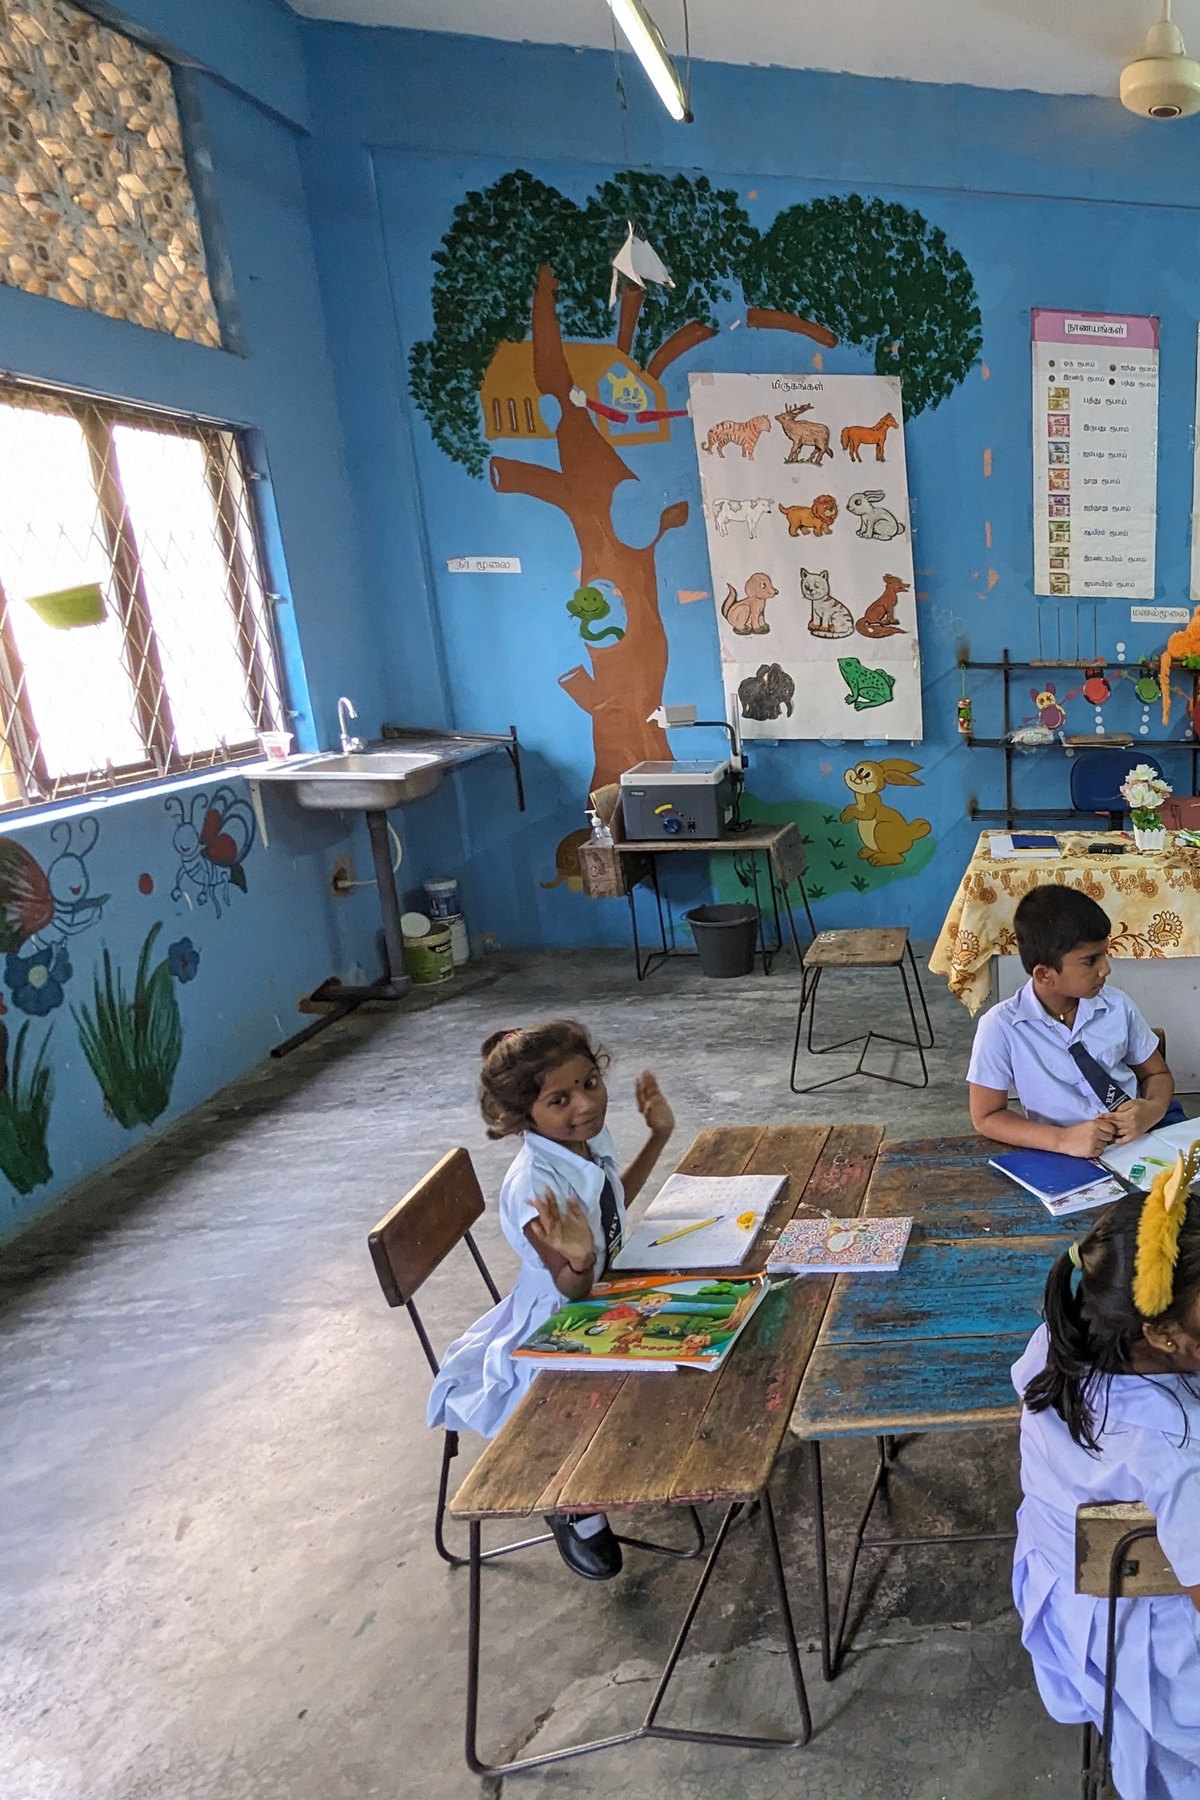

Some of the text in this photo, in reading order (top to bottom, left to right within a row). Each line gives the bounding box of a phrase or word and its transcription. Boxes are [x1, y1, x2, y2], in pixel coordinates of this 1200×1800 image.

[1067, 323, 1124, 335] நாணயங்கள்
[771, 379, 824, 392] மிருகங்கள்
[1083, 397, 1101, 405] பத்து
[1083, 424, 1129, 433] இருபது ரூபாய்
[1082, 450, 1128, 459] ஐம்பது ரூபாய்
[1111, 505, 1131, 513] ரூபாய்
[1083, 555, 1147, 563] இரண்டாயிரம் ரூபாய்
[476, 561, 510, 571] மூலை
[1084, 580, 1135, 589] ஐயாயிரம் ரூபாய்
[1106, 1084, 1116, 1104] RKV
